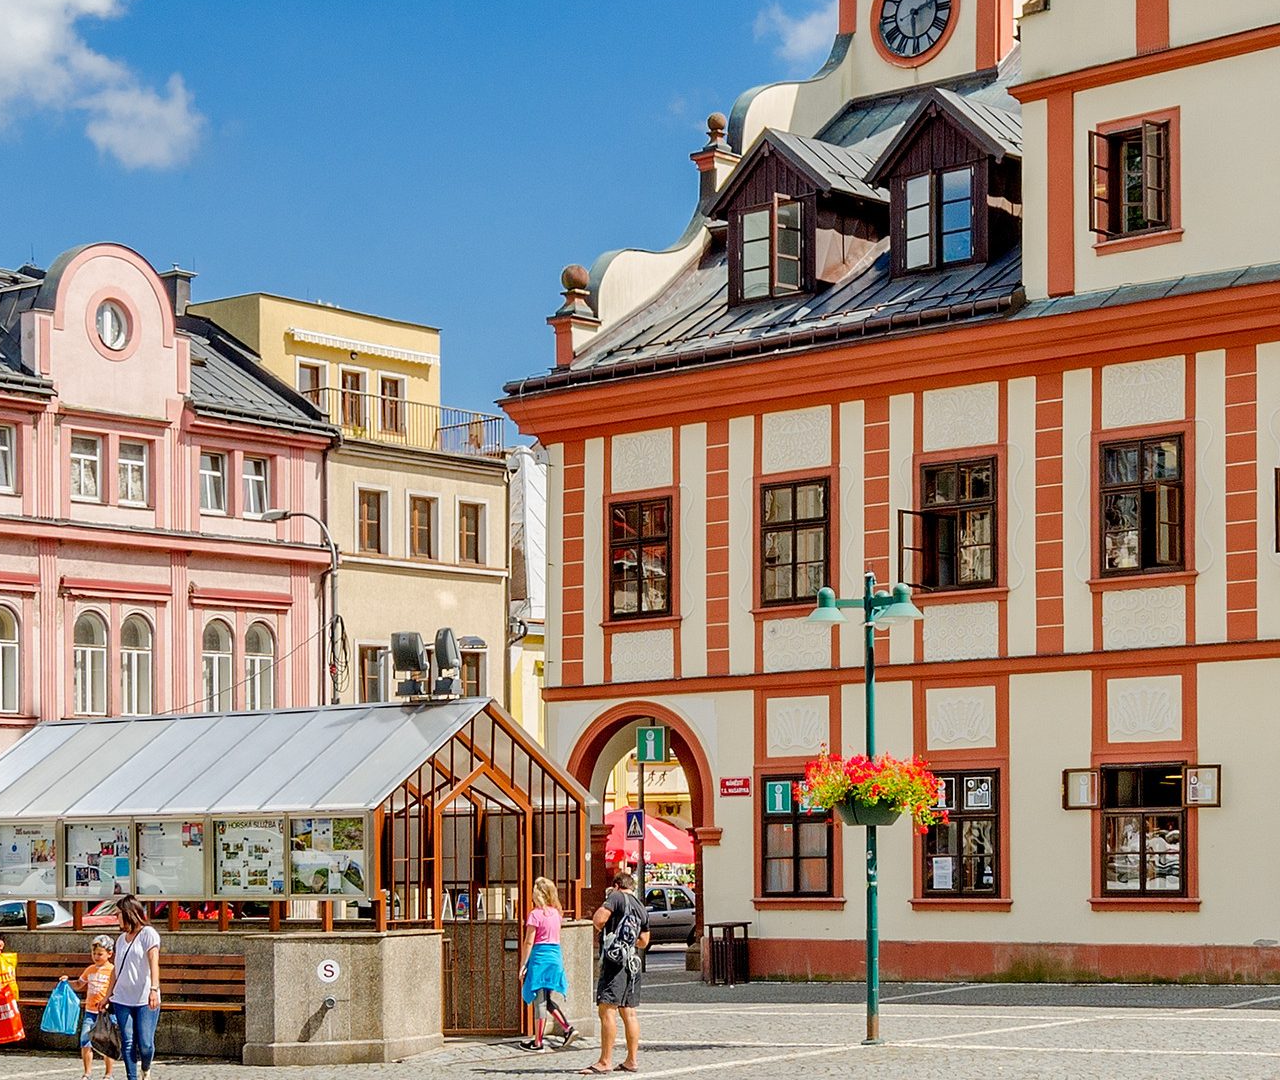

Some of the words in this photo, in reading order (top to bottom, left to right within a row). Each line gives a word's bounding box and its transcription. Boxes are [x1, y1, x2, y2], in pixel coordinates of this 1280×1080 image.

[228, 820, 252, 829] HORSKÁ
[253, 820, 276, 829] SLUŽBA
[323, 964, 335, 978] S
